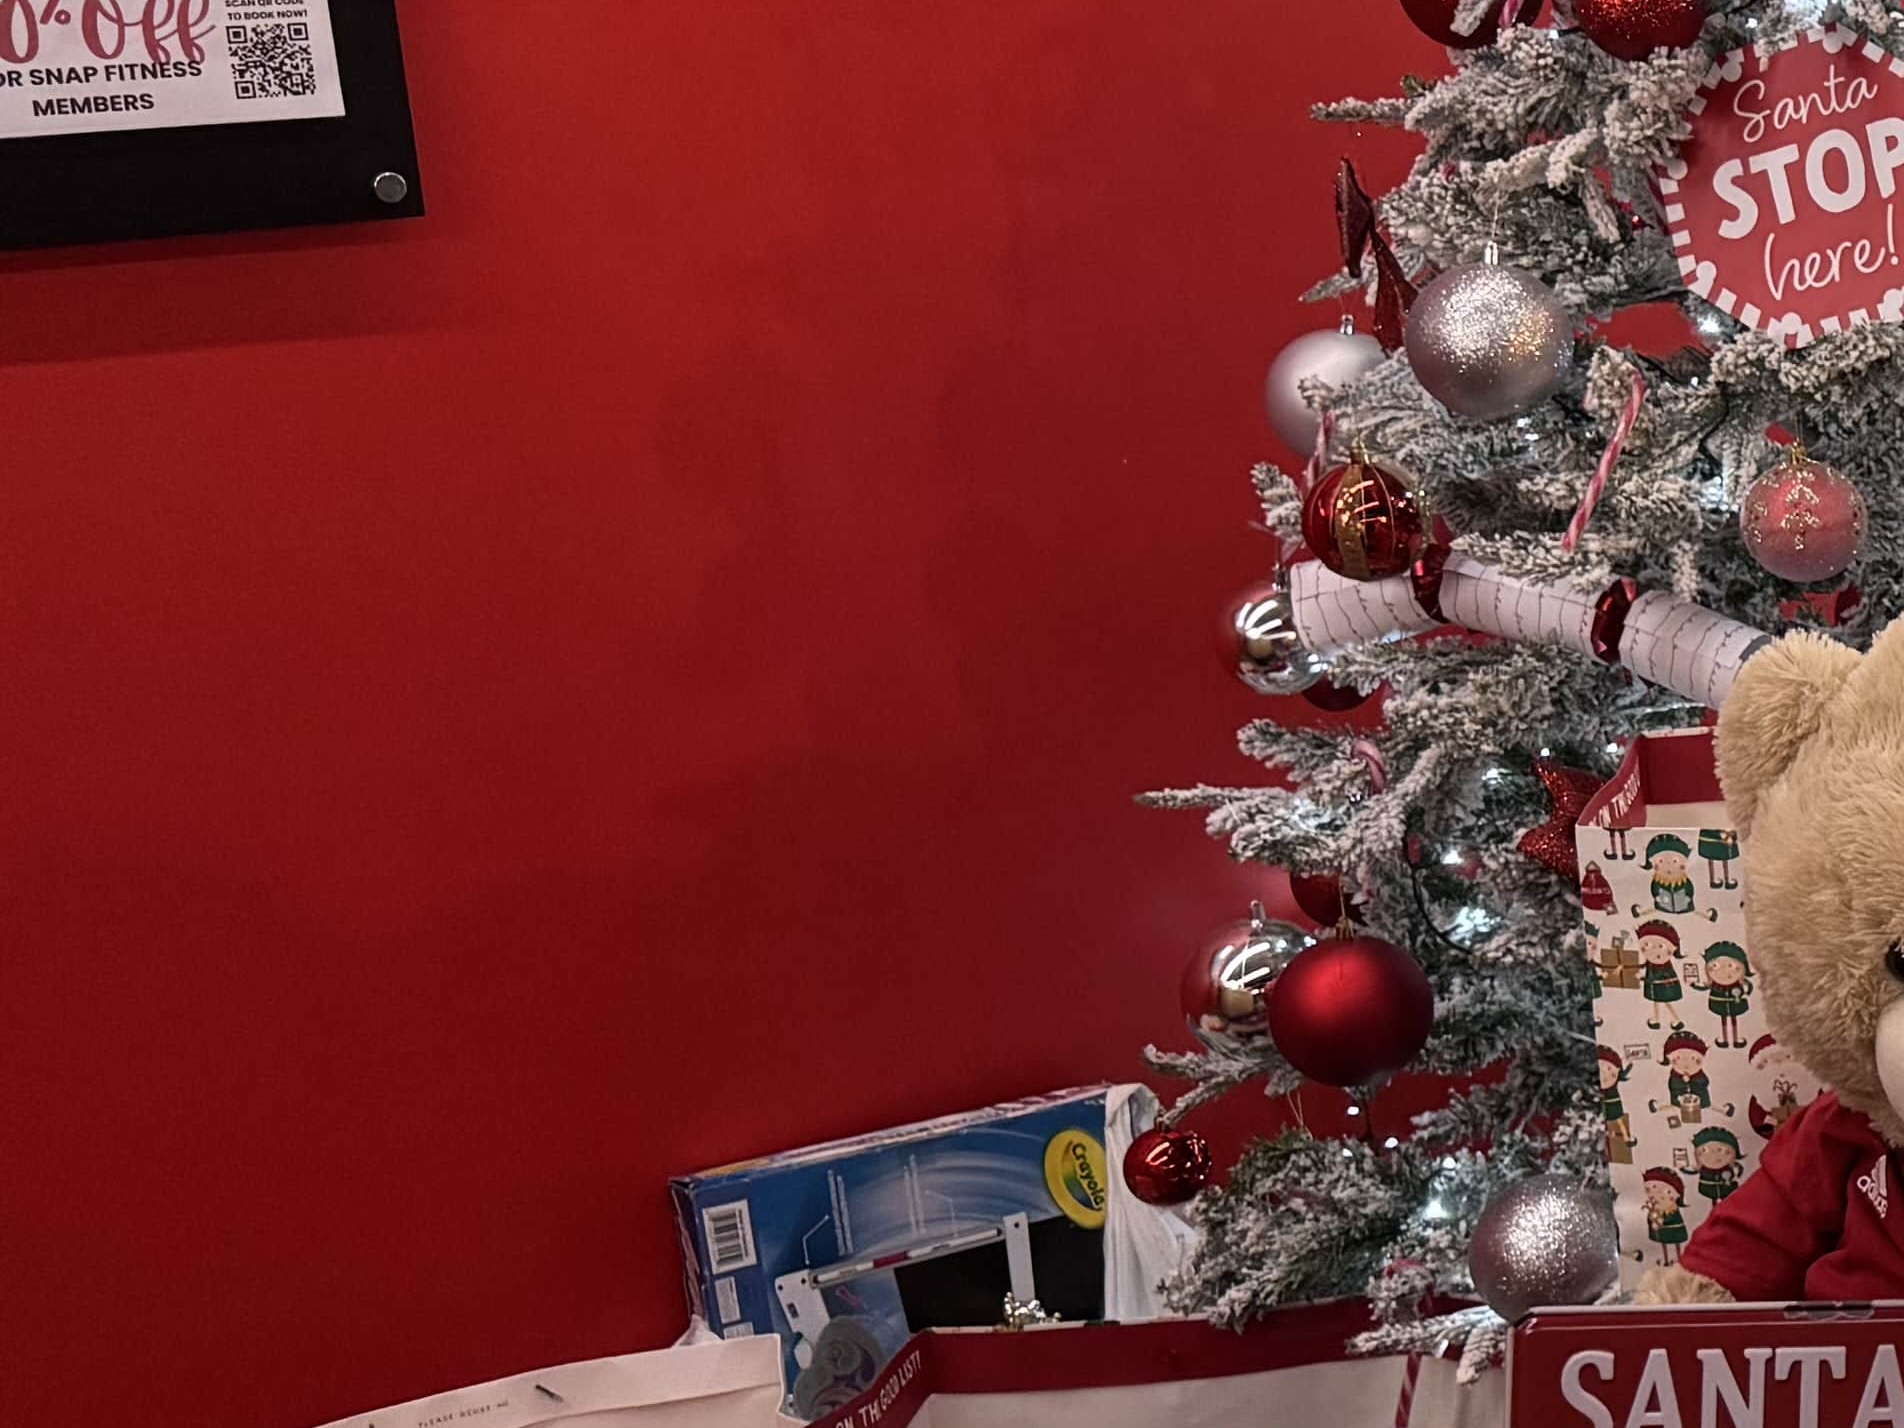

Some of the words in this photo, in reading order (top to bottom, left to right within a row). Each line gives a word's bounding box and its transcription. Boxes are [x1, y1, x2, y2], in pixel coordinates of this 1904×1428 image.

[244, 11, 274, 21] BOOK
[30, 66, 98, 86] SNAP
[104, 60, 202, 82] FITNESS
[32, 93, 155, 117] MEMBERS
[1733, 64, 1879, 144] Santa
[1764, 203, 1902, 301] here!
[1070, 1142, 1105, 1215] Crayola
[879, 1376, 899, 1412] GOOD
